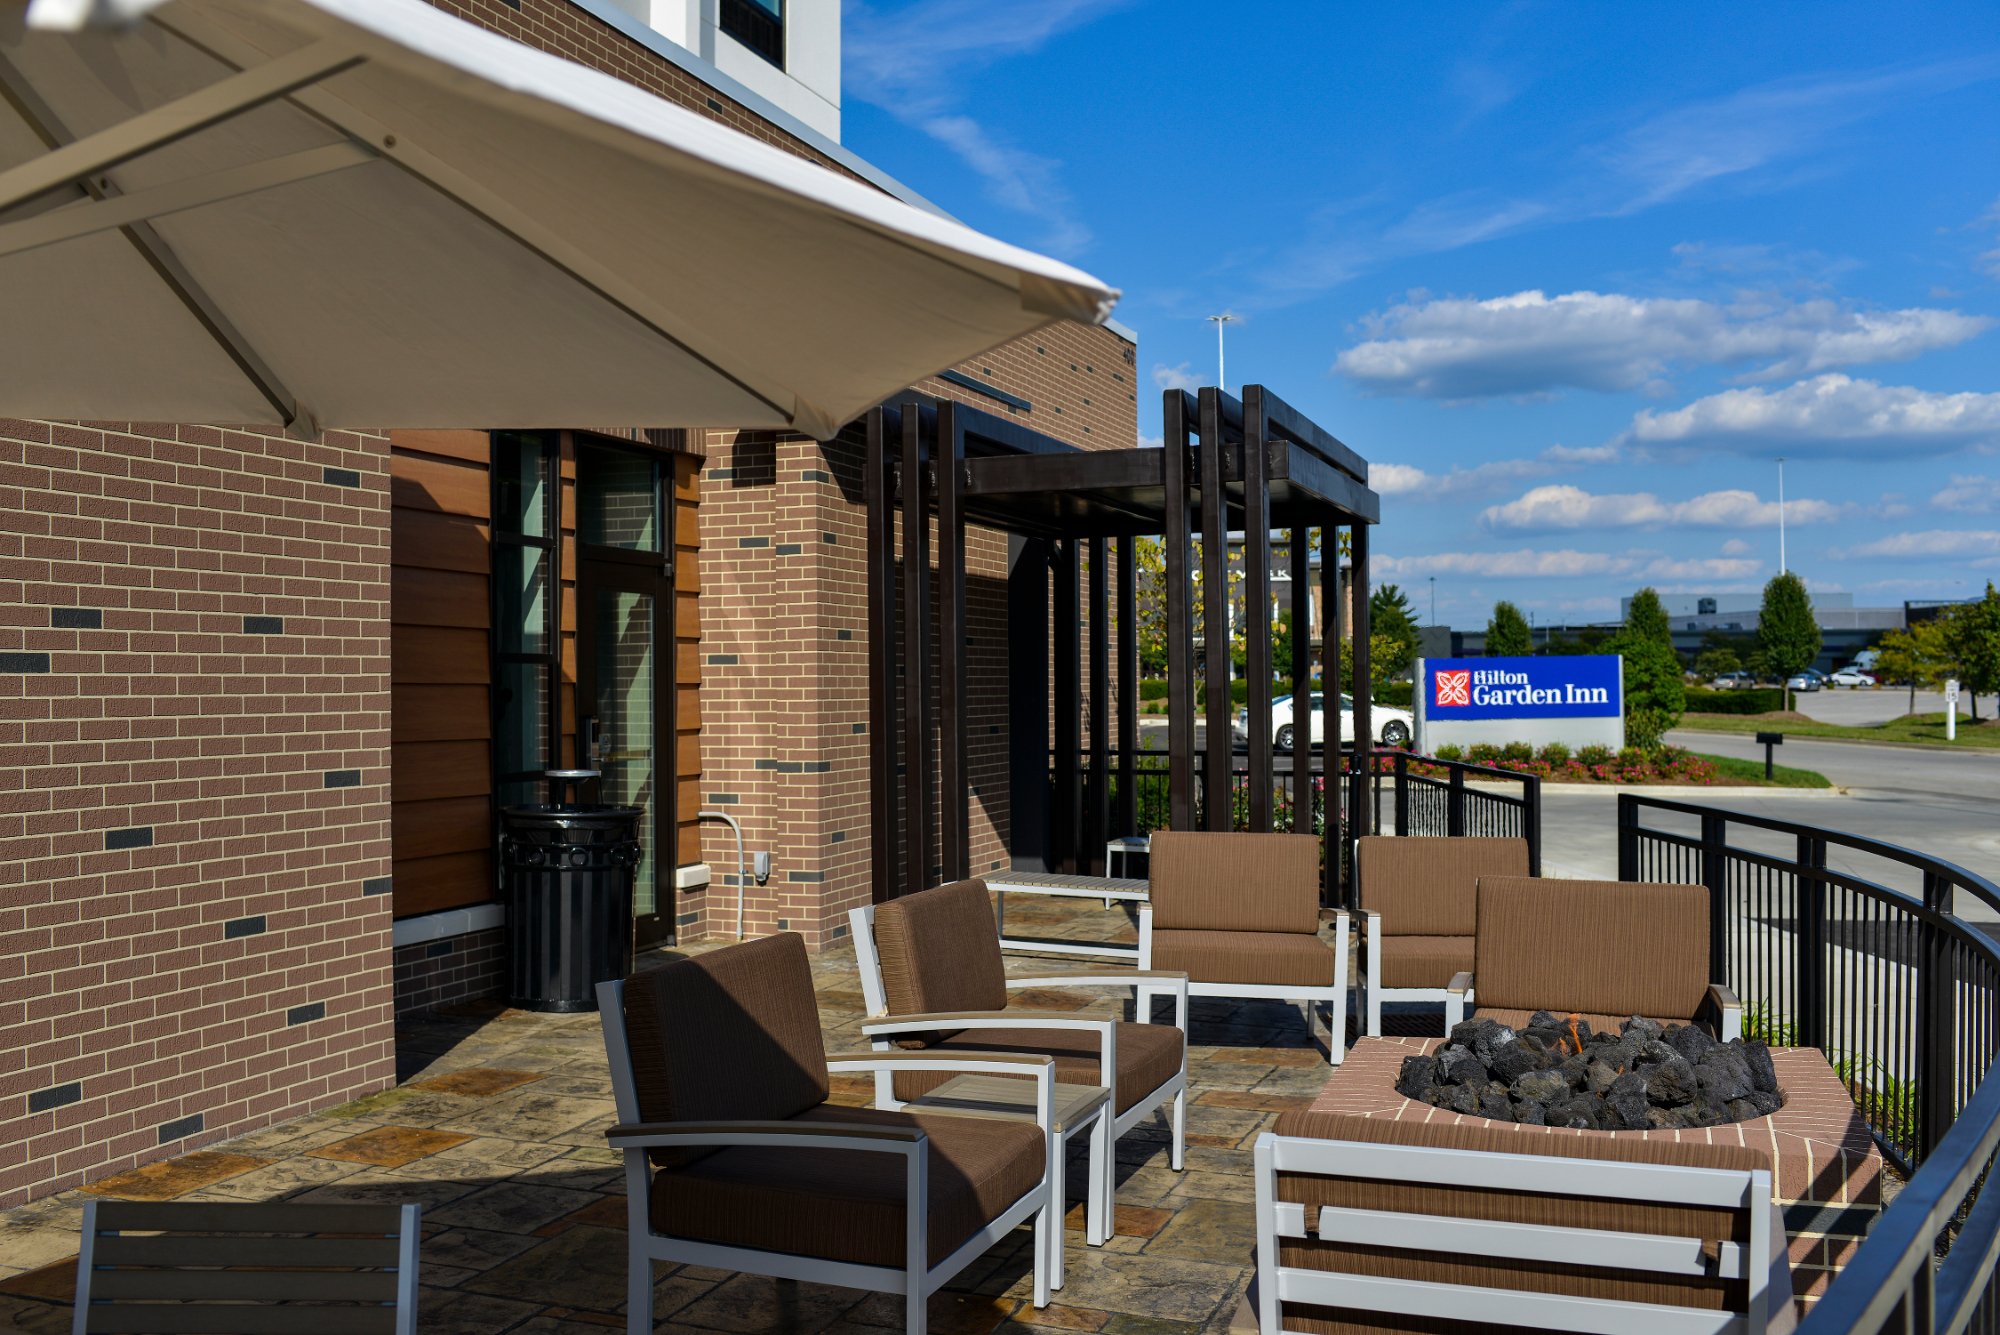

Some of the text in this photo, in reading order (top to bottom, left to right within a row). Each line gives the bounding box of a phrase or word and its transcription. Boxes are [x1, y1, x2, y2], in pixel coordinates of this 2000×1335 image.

[1473, 670, 1529, 685] Hilton
[1473, 683, 1609, 705] Garden Inn
